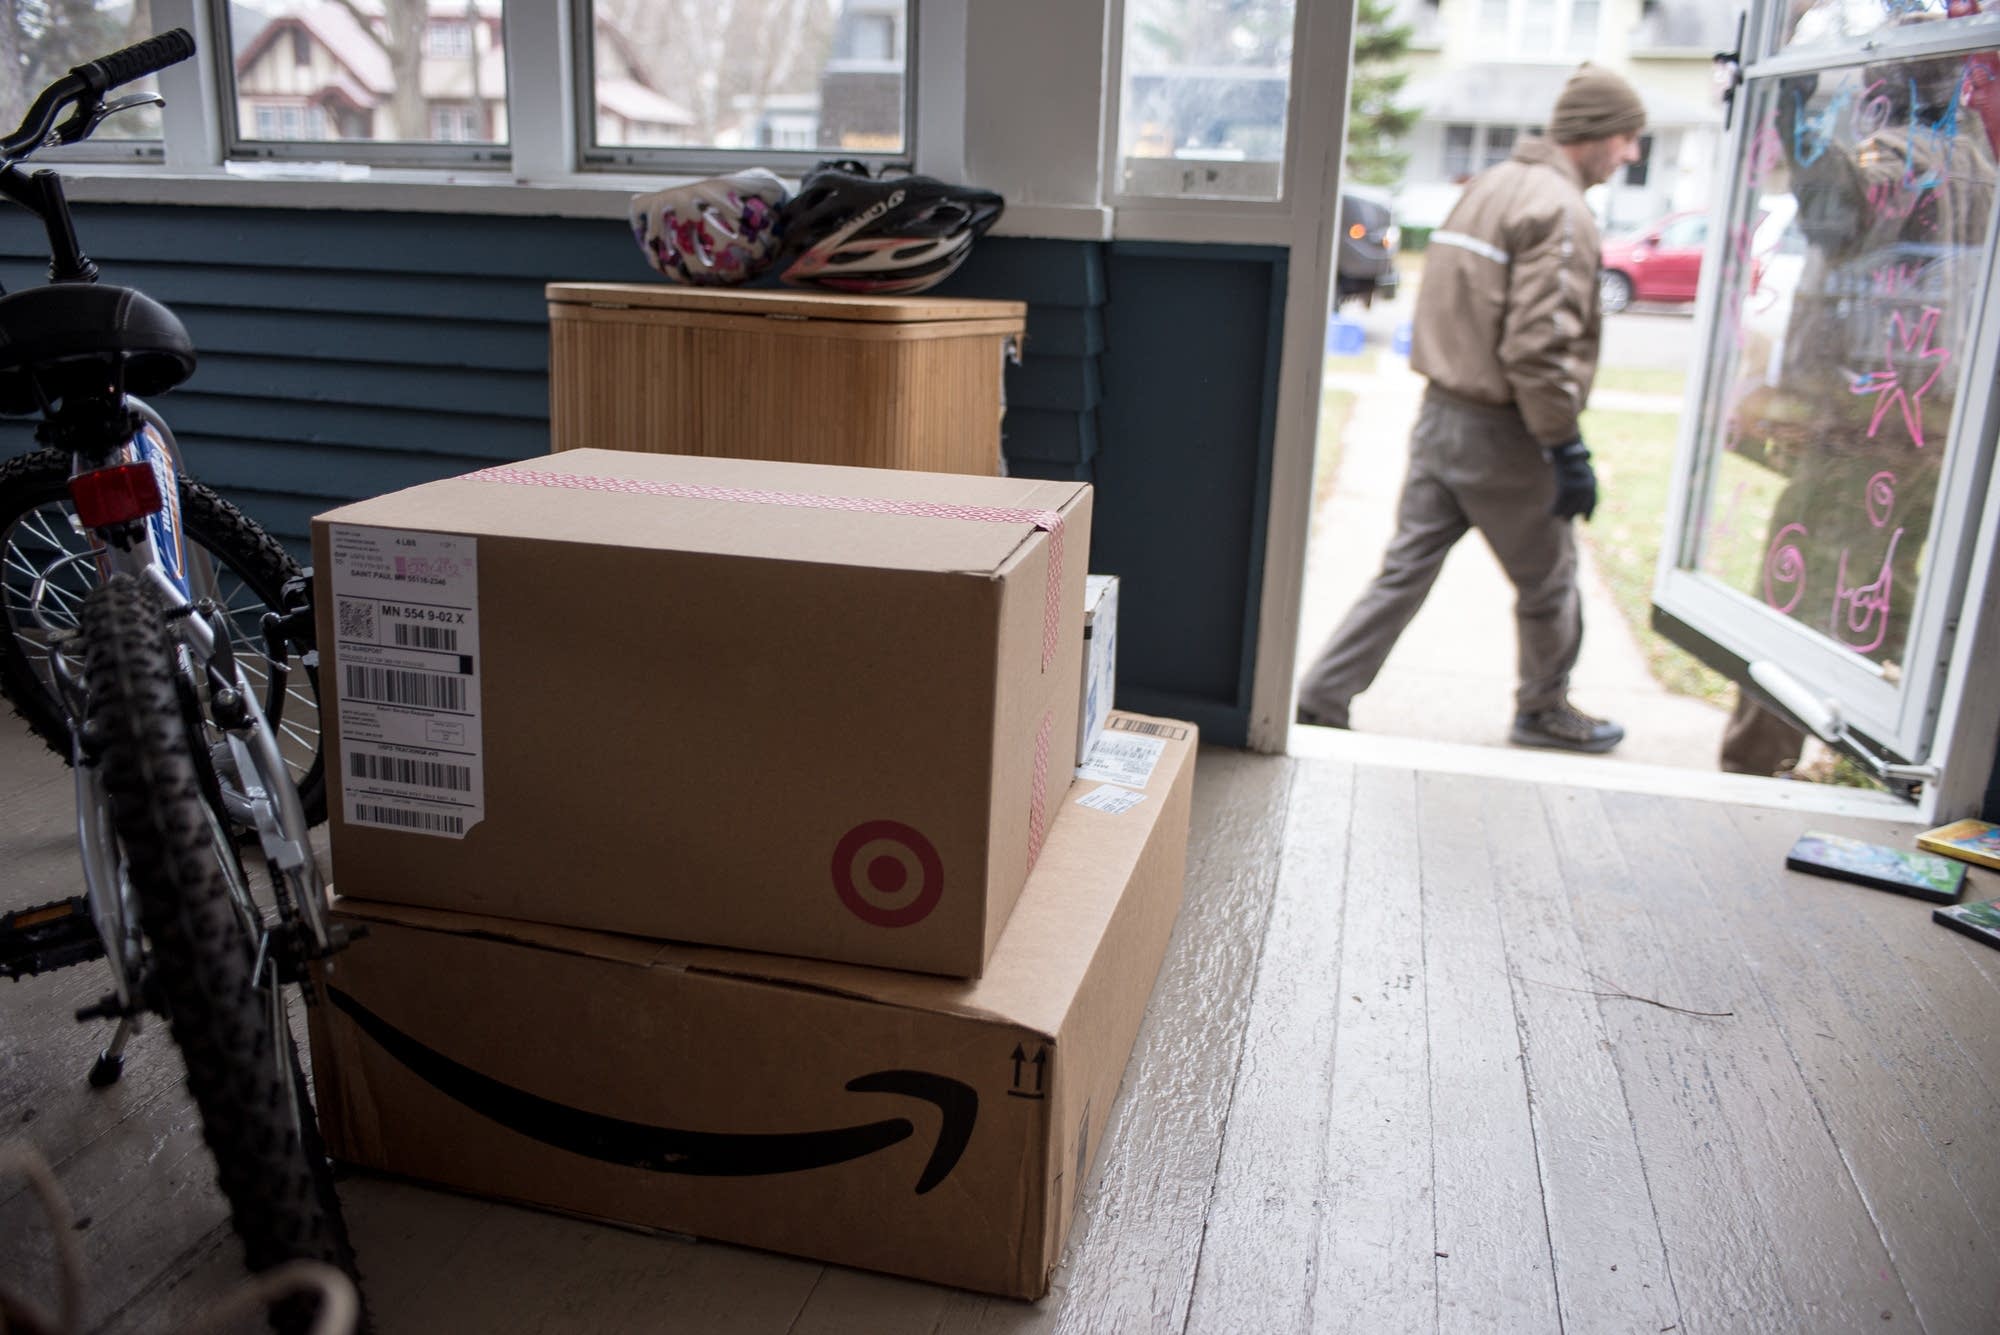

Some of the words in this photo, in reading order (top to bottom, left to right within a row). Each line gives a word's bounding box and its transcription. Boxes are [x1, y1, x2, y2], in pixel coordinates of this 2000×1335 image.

[402, 539, 417, 547] LBS
[350, 570, 372, 579] SAINT
[381, 605, 401, 617] MN
[404, 608, 425, 620] 554
[426, 610, 453, 624] 9-02
[455, 613, 465, 625] X
